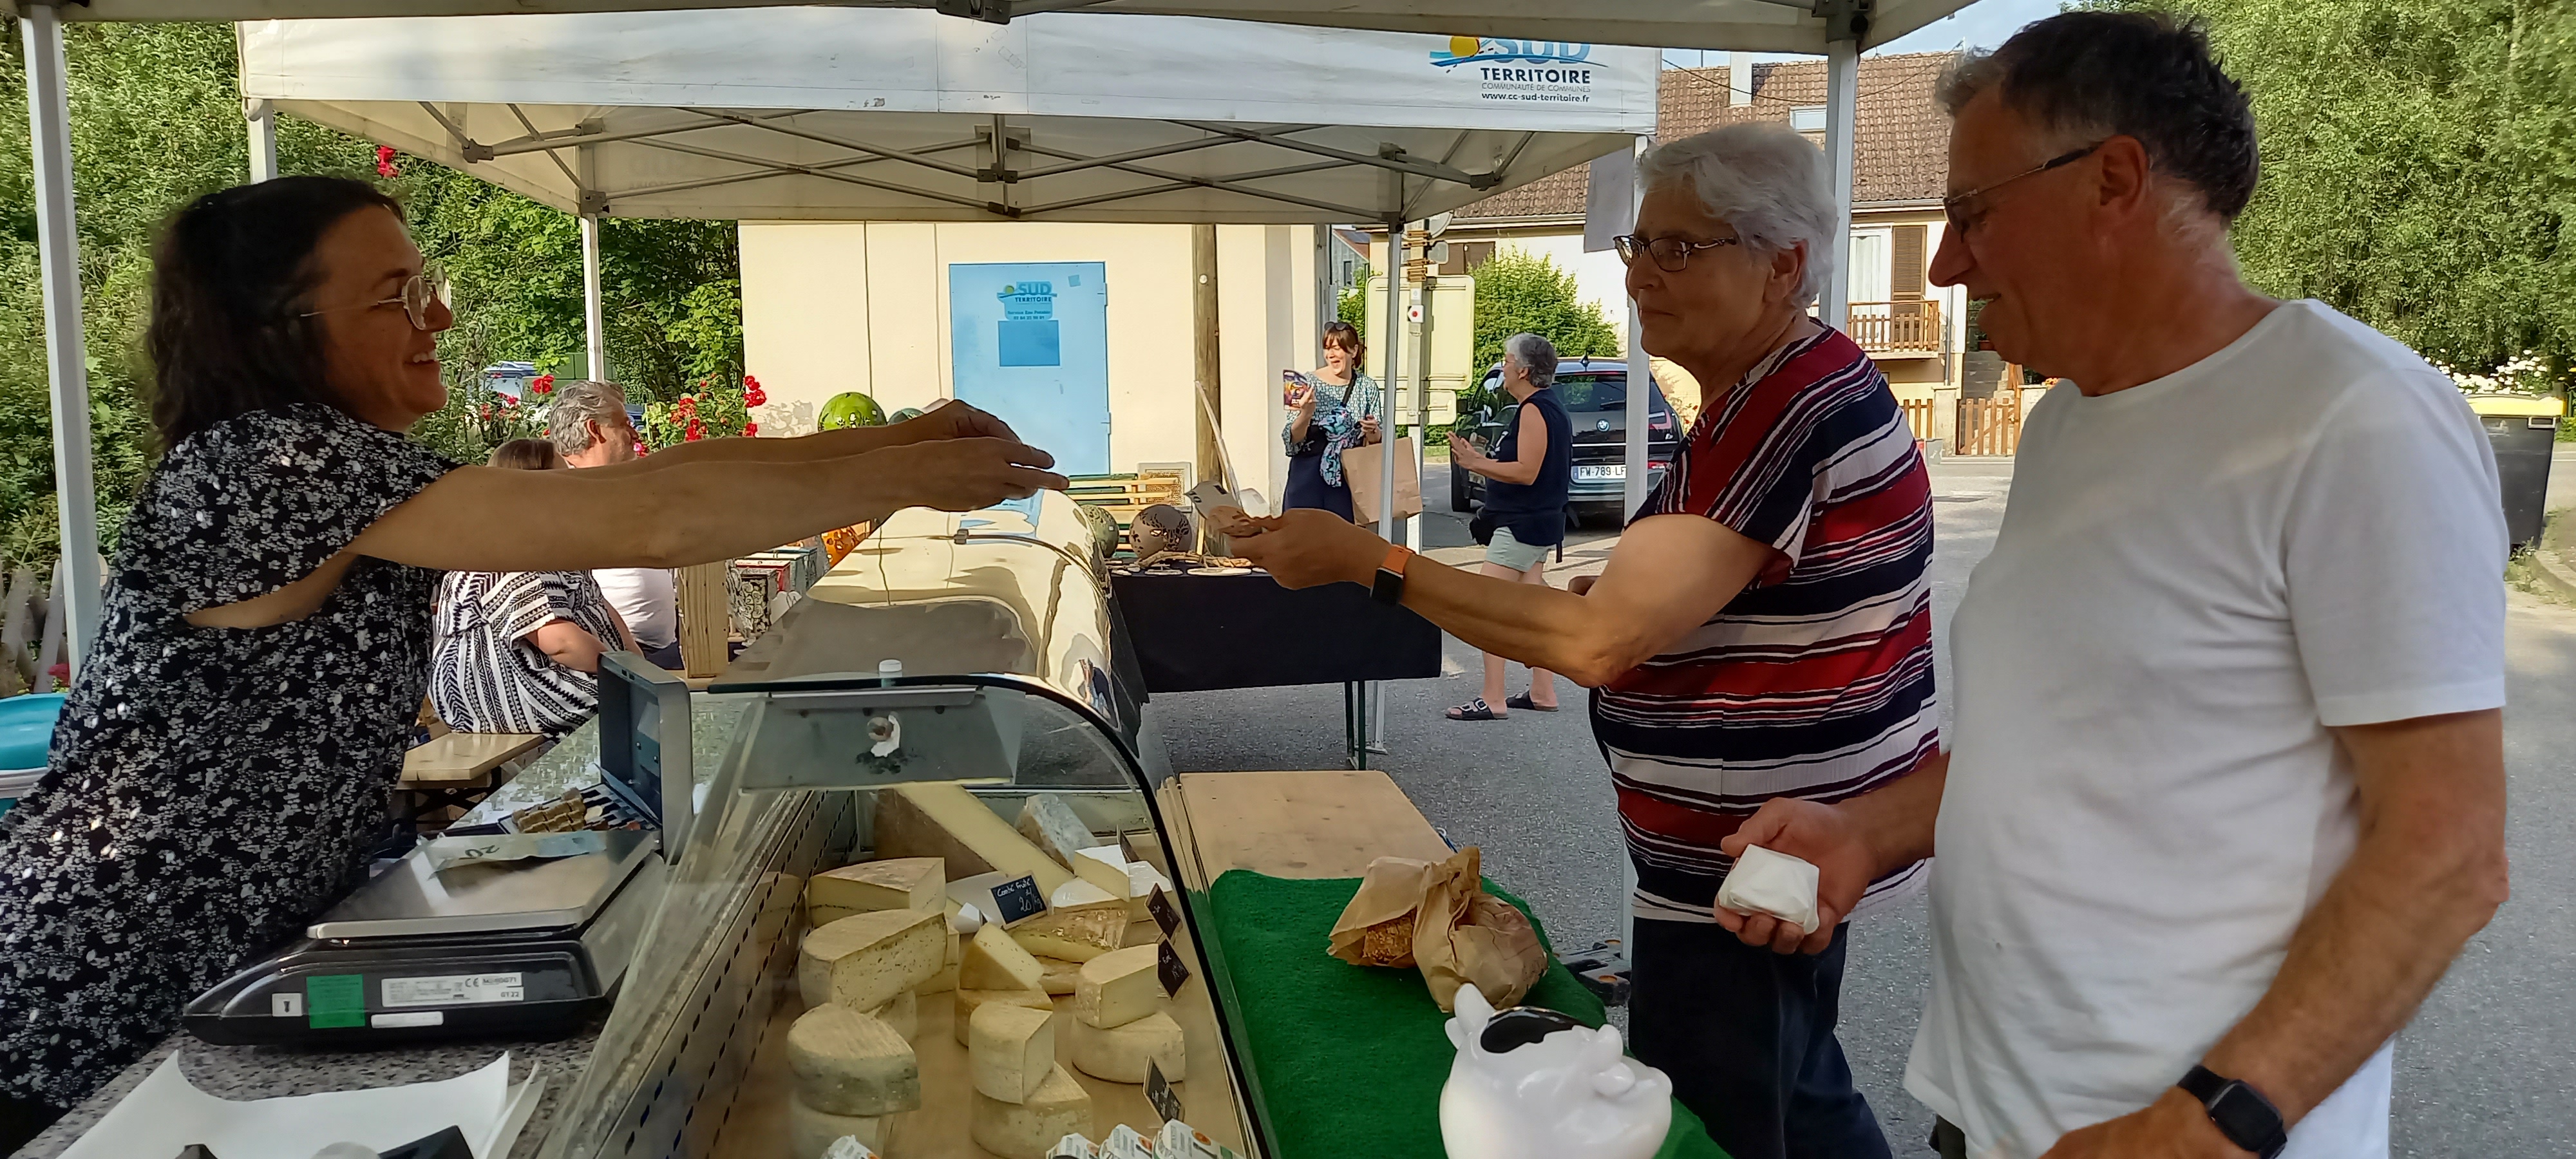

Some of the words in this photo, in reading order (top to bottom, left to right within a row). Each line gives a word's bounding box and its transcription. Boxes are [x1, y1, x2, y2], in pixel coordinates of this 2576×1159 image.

[1494, 39, 1590, 64] SUD
[1480, 67, 1591, 84] TERRITOIRE
[1481, 82, 1535, 91] COMMUNAUTÉ
[1548, 84, 1591, 93] COMMUNES
[1481, 93, 1590, 103] www.cc-sud-territoire.fr
[1018, 283, 1052, 296] SUD
